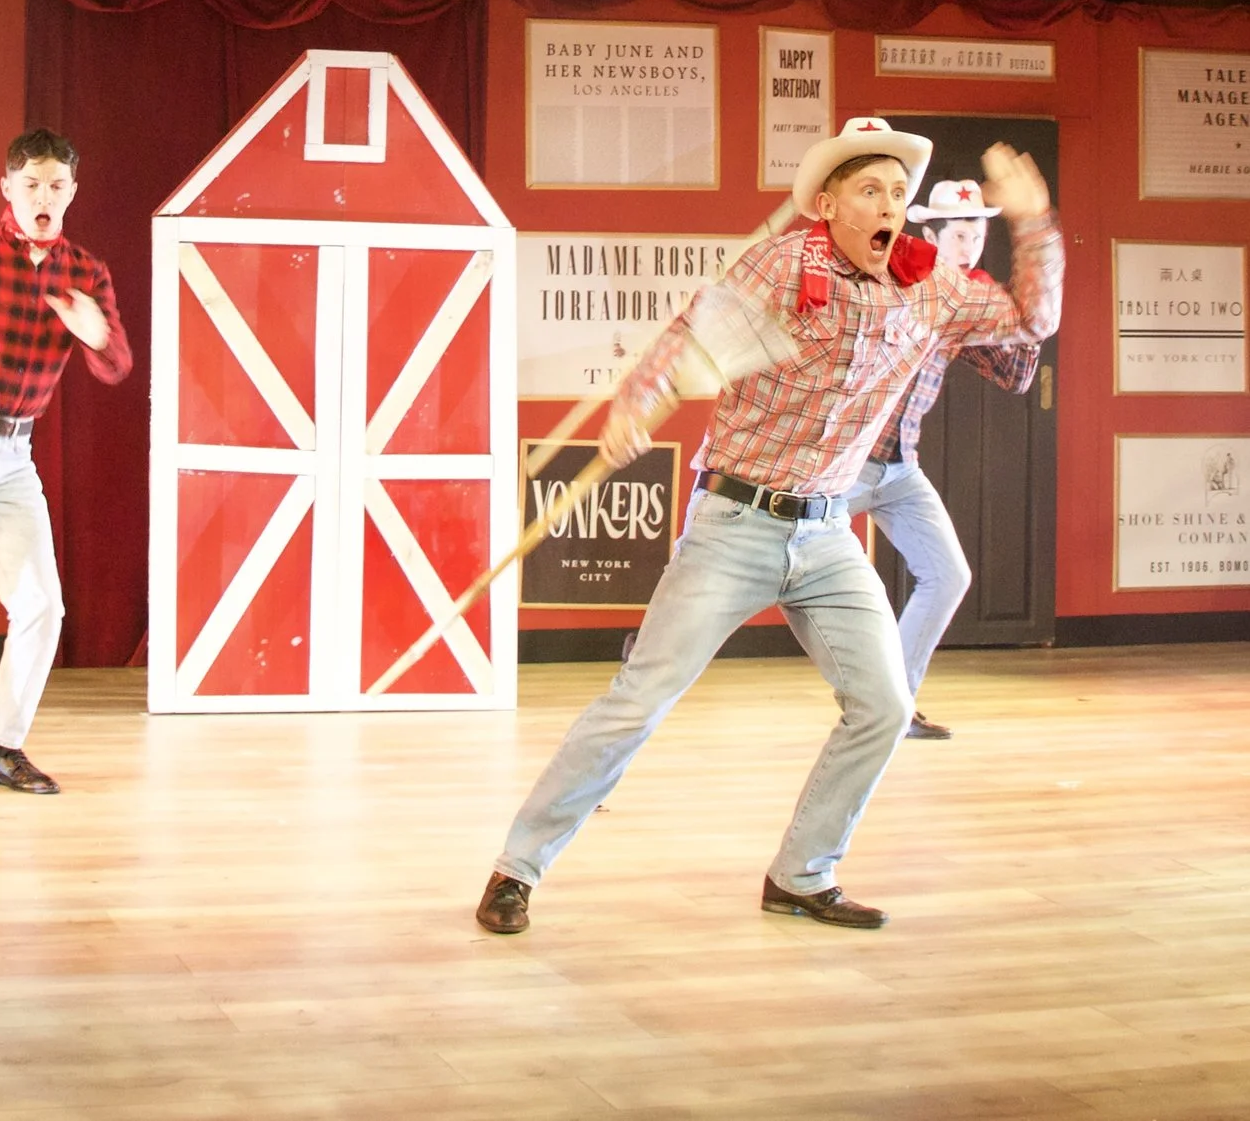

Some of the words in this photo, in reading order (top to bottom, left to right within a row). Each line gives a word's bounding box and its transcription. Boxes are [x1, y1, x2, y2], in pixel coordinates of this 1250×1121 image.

[546, 43, 597, 58] BABY
[604, 43, 654, 60] JUNE
[664, 46, 705, 60] AND
[779, 49, 814, 70] HAPPY
[545, 64, 583, 78] HER
[593, 65, 707, 84] NEWSBOYS,
[573, 83, 603, 97] LOS
[610, 85, 680, 98] ANGELES
[772, 77, 821, 100] BIRTHDAY
[547, 244, 643, 277] MADAME
[1119, 300, 1160, 317] TABLE
[1168, 300, 1201, 317] FOR
[1211, 301, 1244, 317] TWO
[1127, 354, 1156, 363] NEW
[1163, 354, 1199, 363] YORK
[1205, 354, 1238, 363] CITY
[532, 480, 666, 540] YONKERS
[1118, 512, 1165, 527] SHOE
[1172, 512, 1228, 526] SHINE
[1236, 513, 1247, 525] &
[561, 559, 590, 569] NEW
[596, 559, 631, 569] YORK
[579, 572, 612, 582] CITY
